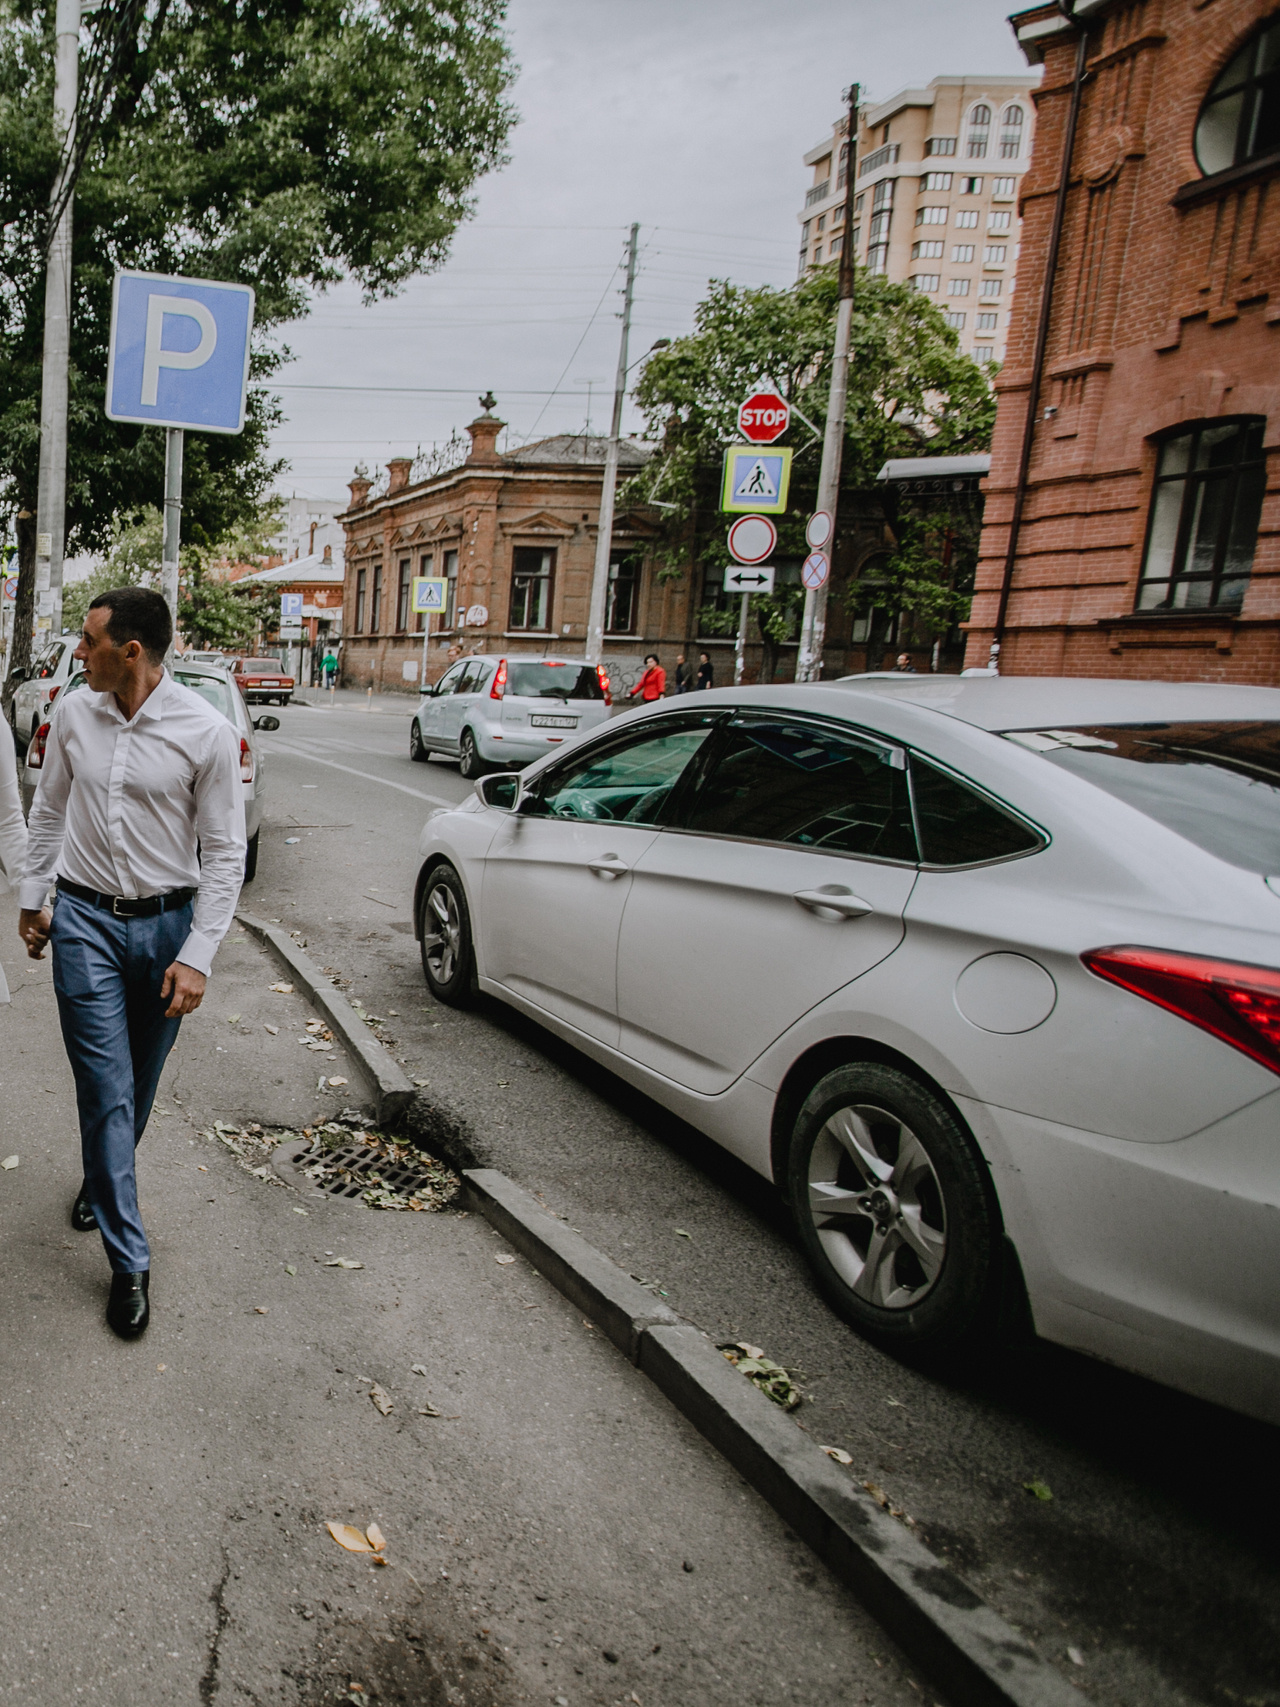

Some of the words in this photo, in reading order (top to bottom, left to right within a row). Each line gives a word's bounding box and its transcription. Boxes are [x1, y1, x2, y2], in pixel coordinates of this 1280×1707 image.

[141, 294, 217, 406] P
[741, 408, 787, 426] STOP
[287, 596, 300, 613] P
